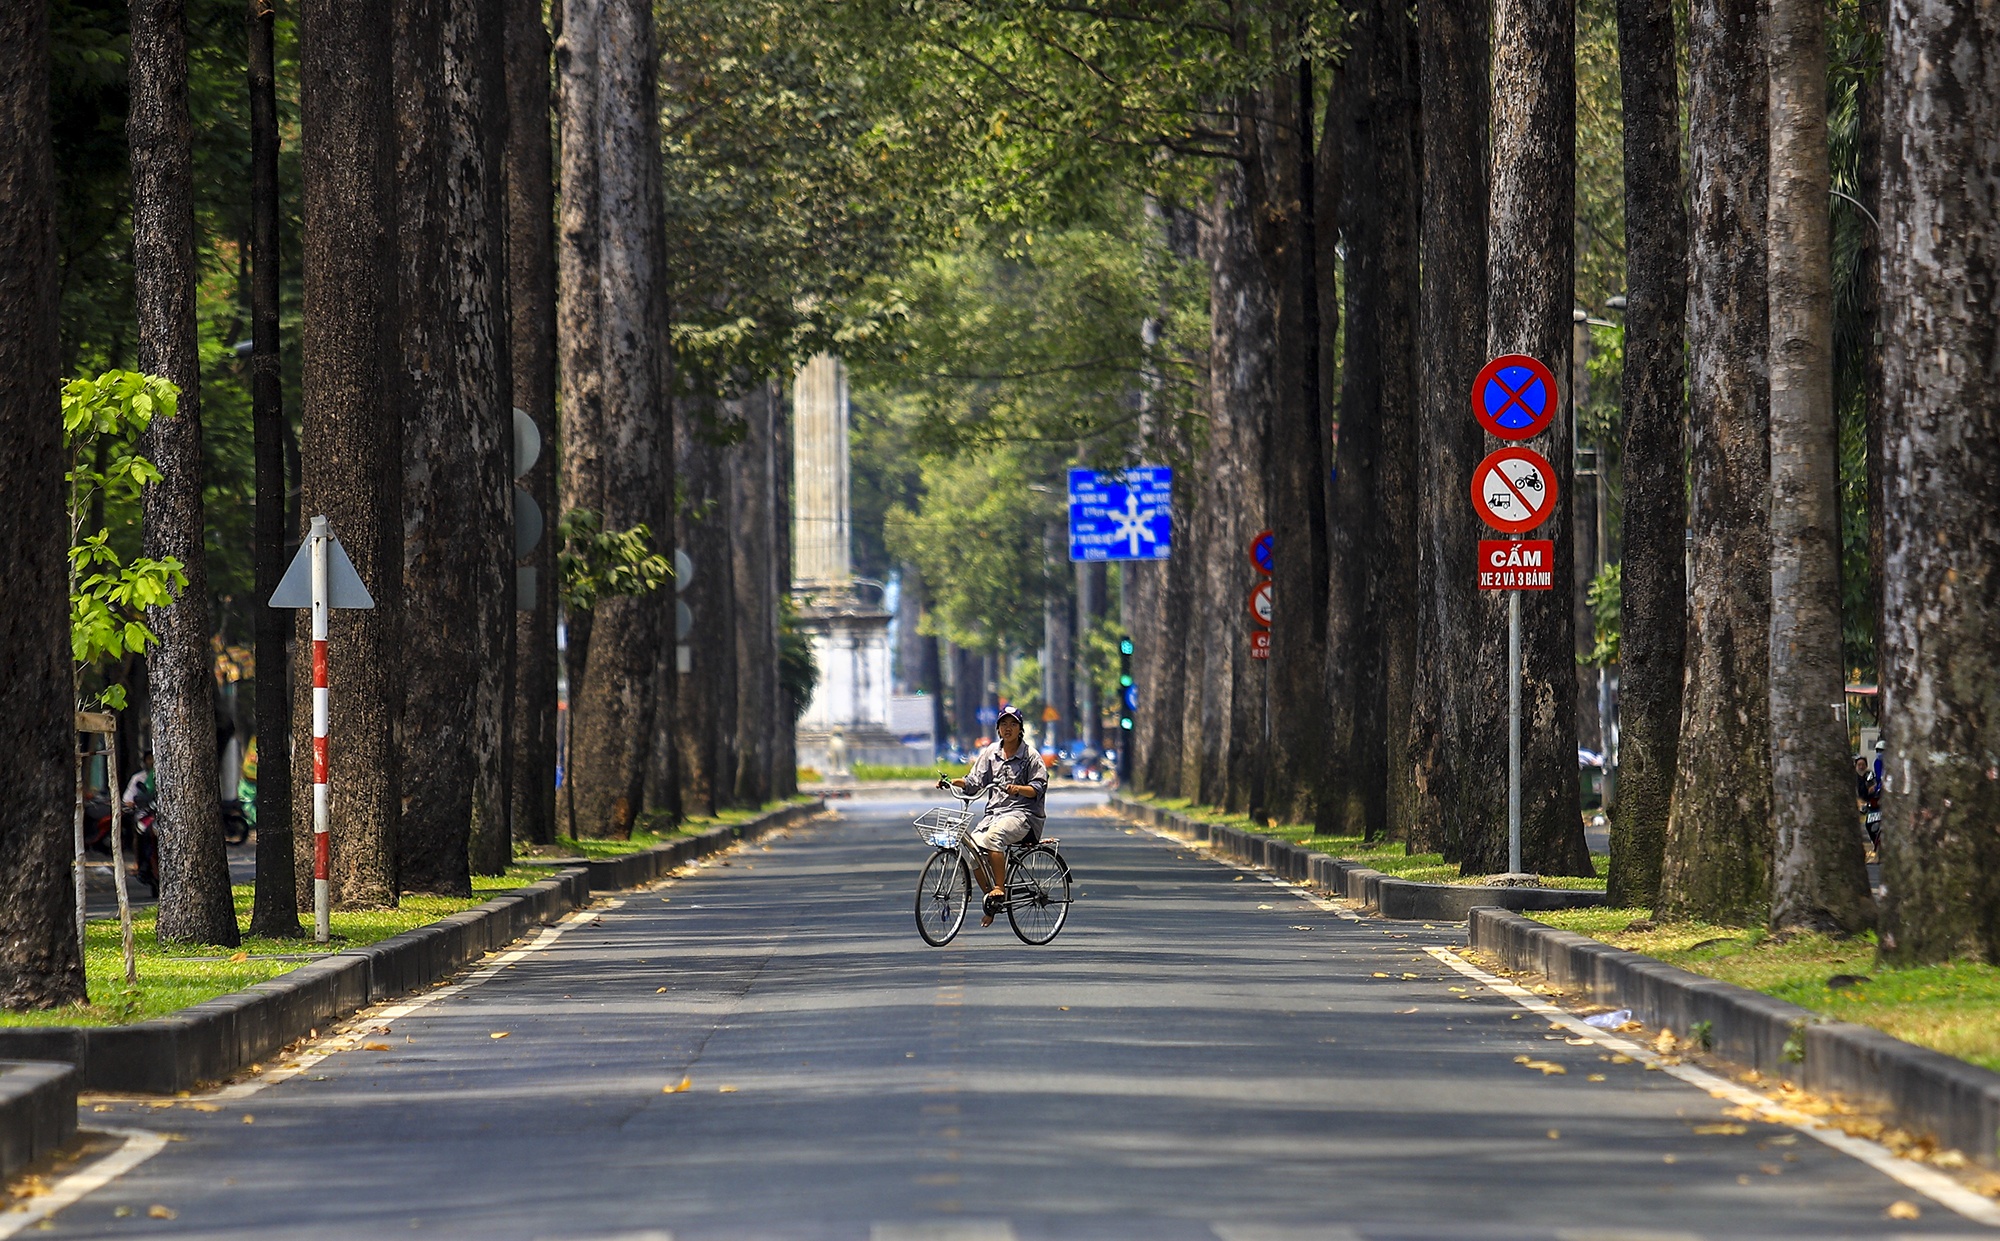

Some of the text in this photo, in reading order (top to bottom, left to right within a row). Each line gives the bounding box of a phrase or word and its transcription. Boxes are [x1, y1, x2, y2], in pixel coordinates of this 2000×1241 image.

[1491, 544, 1541, 567] CẤM
[1481, 569, 1551, 586] XE 2 VÀ 3 BÁNH
